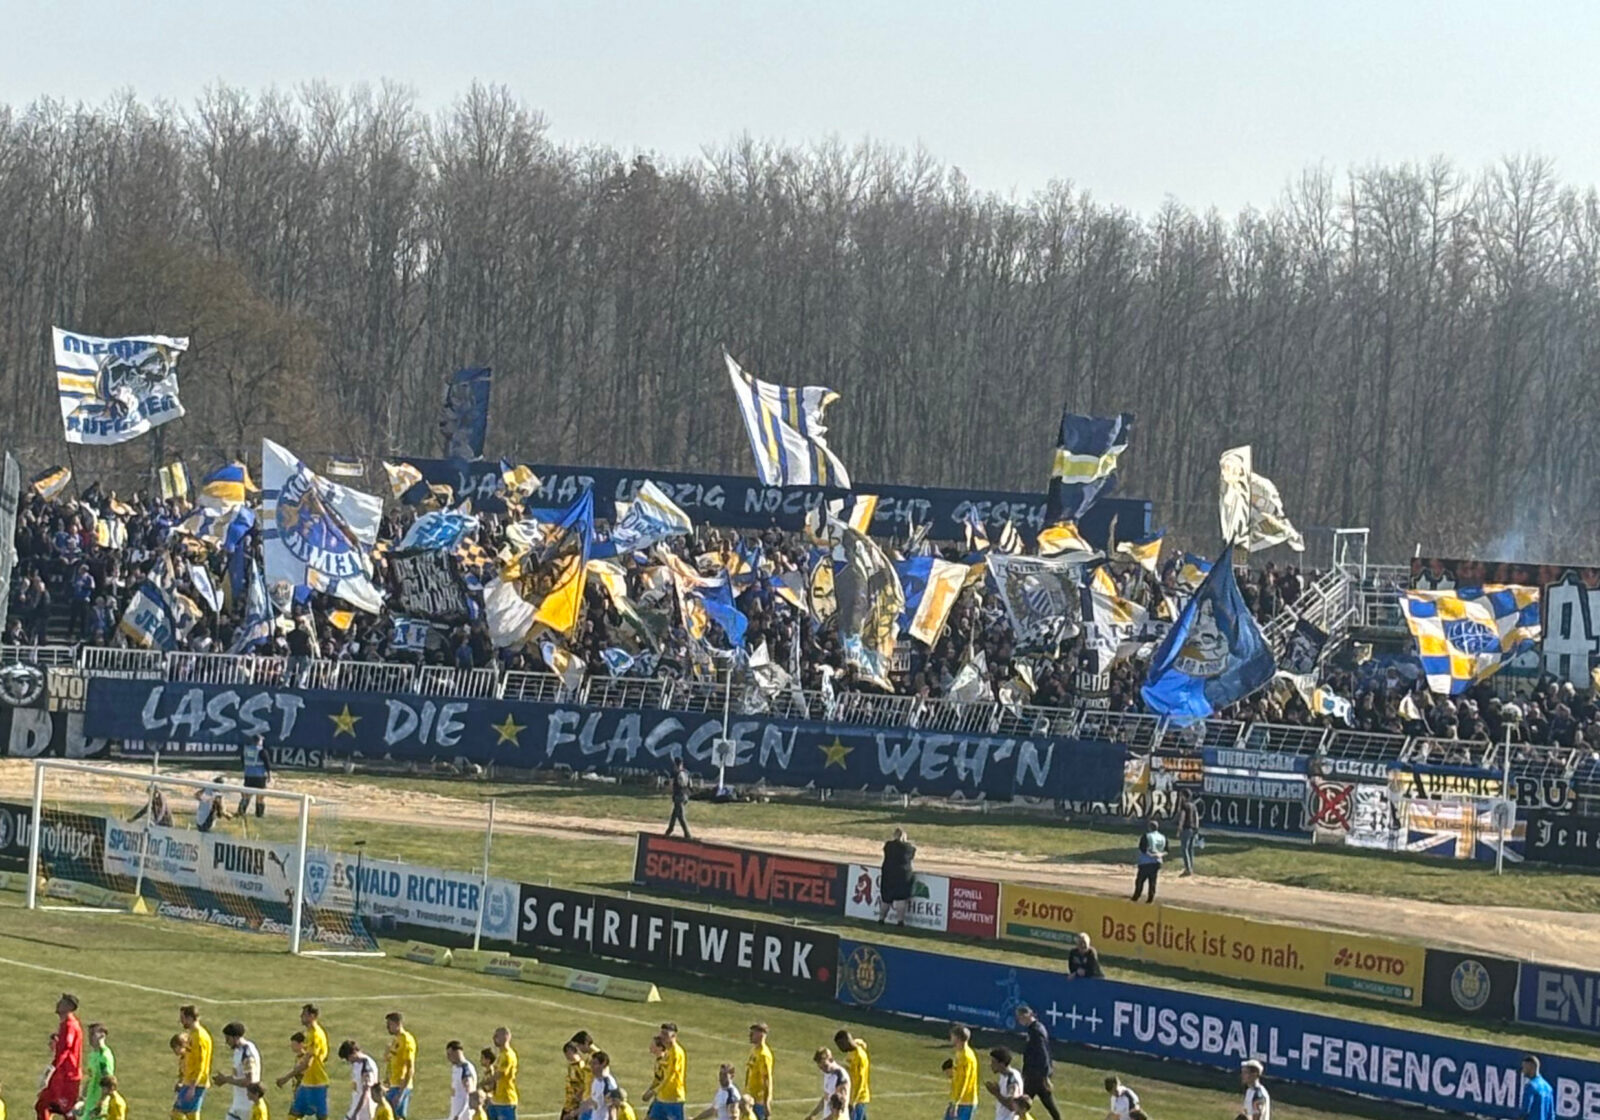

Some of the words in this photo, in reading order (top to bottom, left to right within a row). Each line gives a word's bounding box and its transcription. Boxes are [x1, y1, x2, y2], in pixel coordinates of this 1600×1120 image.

[142, 685, 305, 742] LASST
[384, 699, 469, 748] DIE
[546, 707, 800, 770] FLAGGEN
[1335, 760, 1388, 779] GERA
[164, 836, 199, 862] Teams
[213, 842, 265, 876] PUMA
[406, 874, 480, 911] RICHTER
[1031, 902, 1074, 923] LOTTO
[1102, 915, 1137, 943] Das
[1142, 921, 1197, 953] Glück
[1202, 930, 1227, 958] ist
[1232, 942, 1256, 963] so
[1261, 944, 1305, 971] nah.
[1355, 951, 1406, 976] LOTTO
[1536, 971, 1600, 1027] EN
